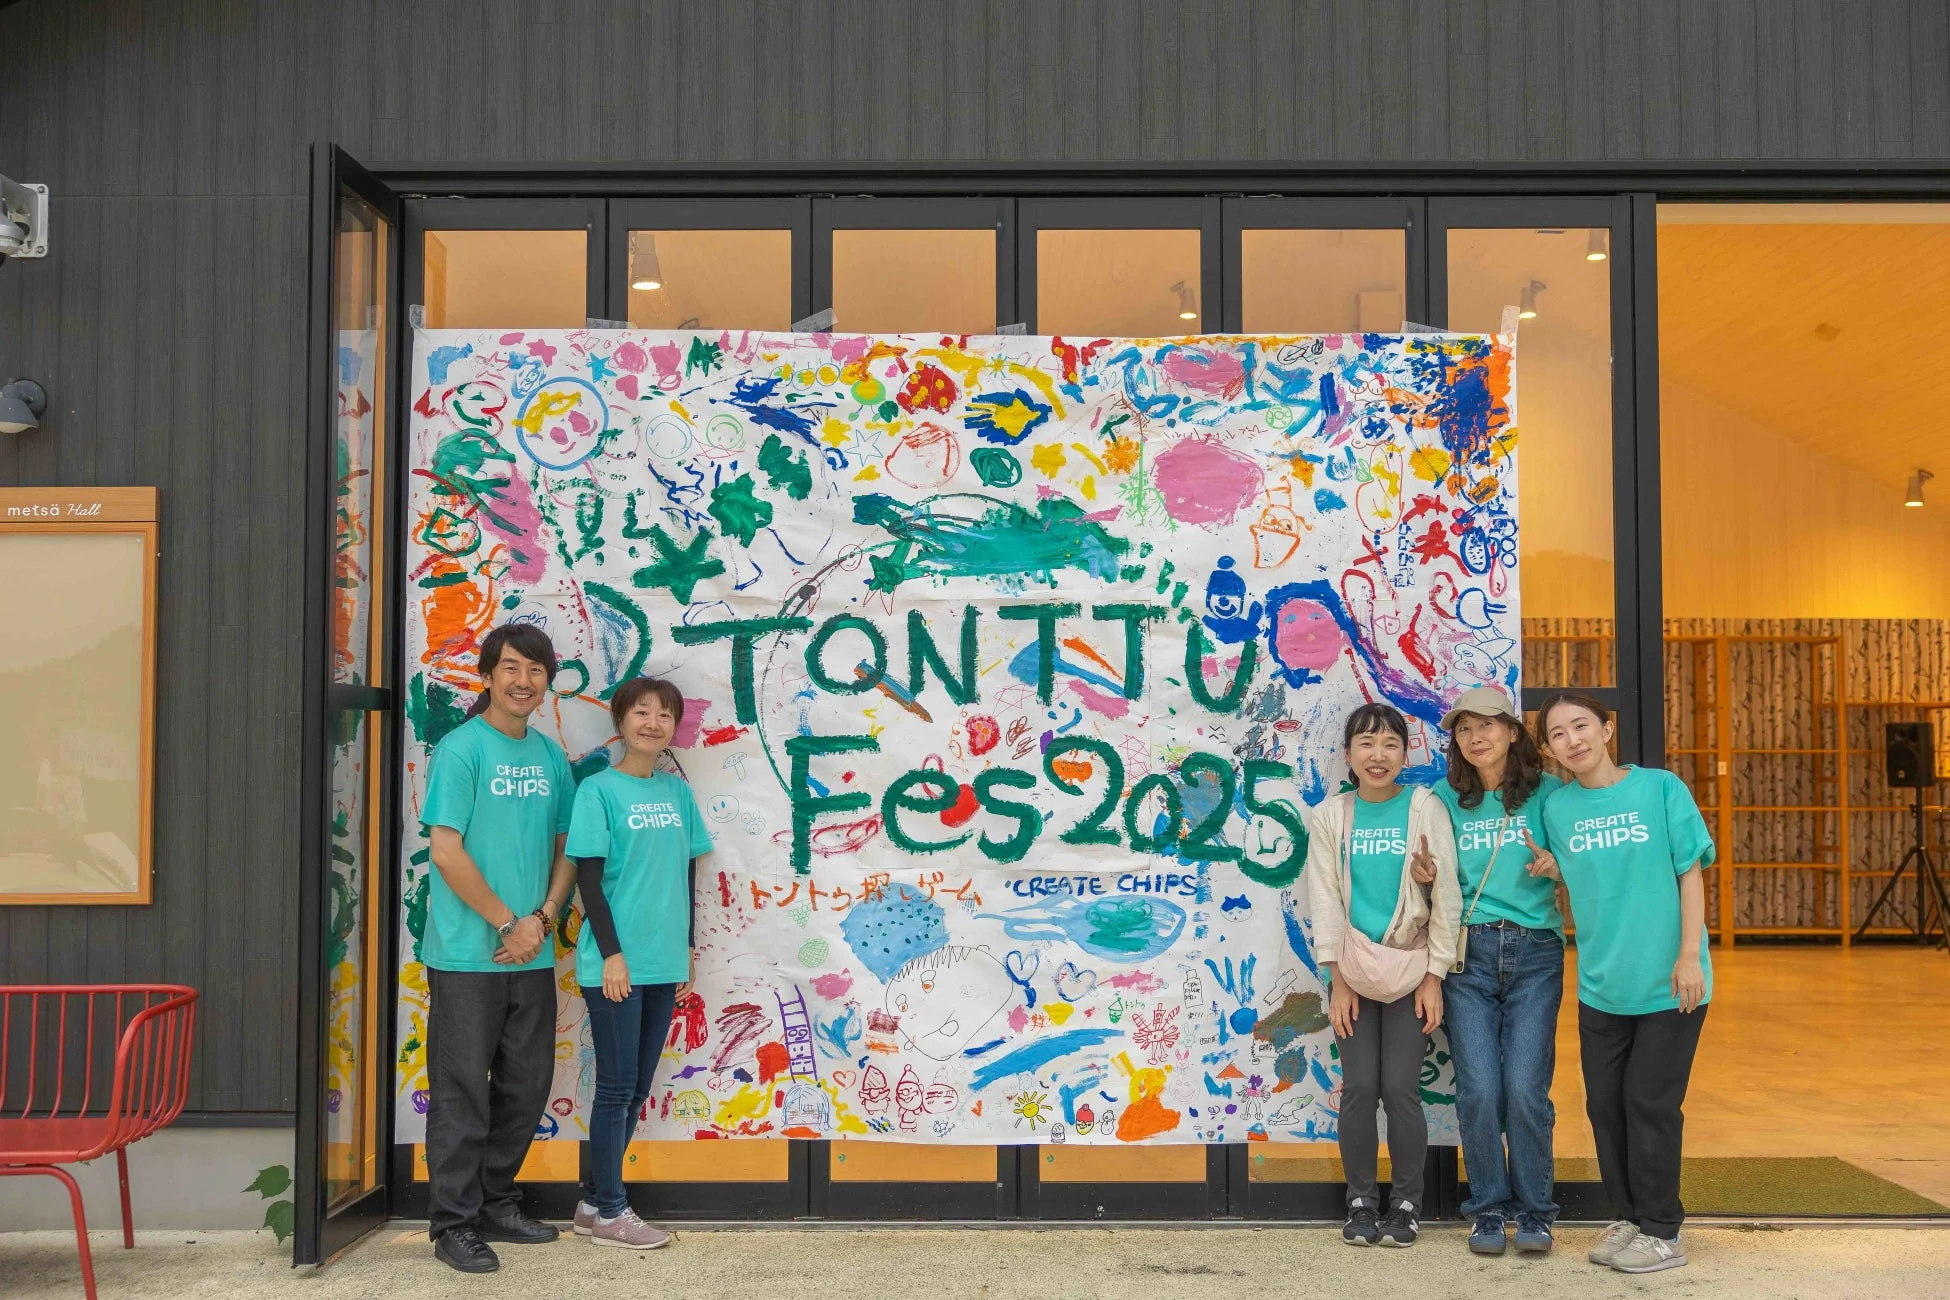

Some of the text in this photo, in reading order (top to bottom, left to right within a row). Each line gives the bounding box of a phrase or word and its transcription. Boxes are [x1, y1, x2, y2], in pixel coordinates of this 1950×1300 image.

[7, 503, 102, 517] metsä Hall
[670, 601, 1259, 725] TONTTU
[496, 764, 545, 778] CREATE
[490, 777, 551, 798] CHIPS
[630, 802, 675, 814] CREATE
[627, 812, 683, 831] CHIPS
[1462, 815, 1527, 832] CREATE
[1574, 811, 1640, 833] CREATE
[1352, 839, 1406, 855] HIPS
[1458, 828, 1534, 852] CHIPS
[1569, 824, 1650, 853] CHIPS
[750, 871, 983, 912] トントゥ探しゲーム
[1012, 874, 1199, 898] CREATE CHIPS
